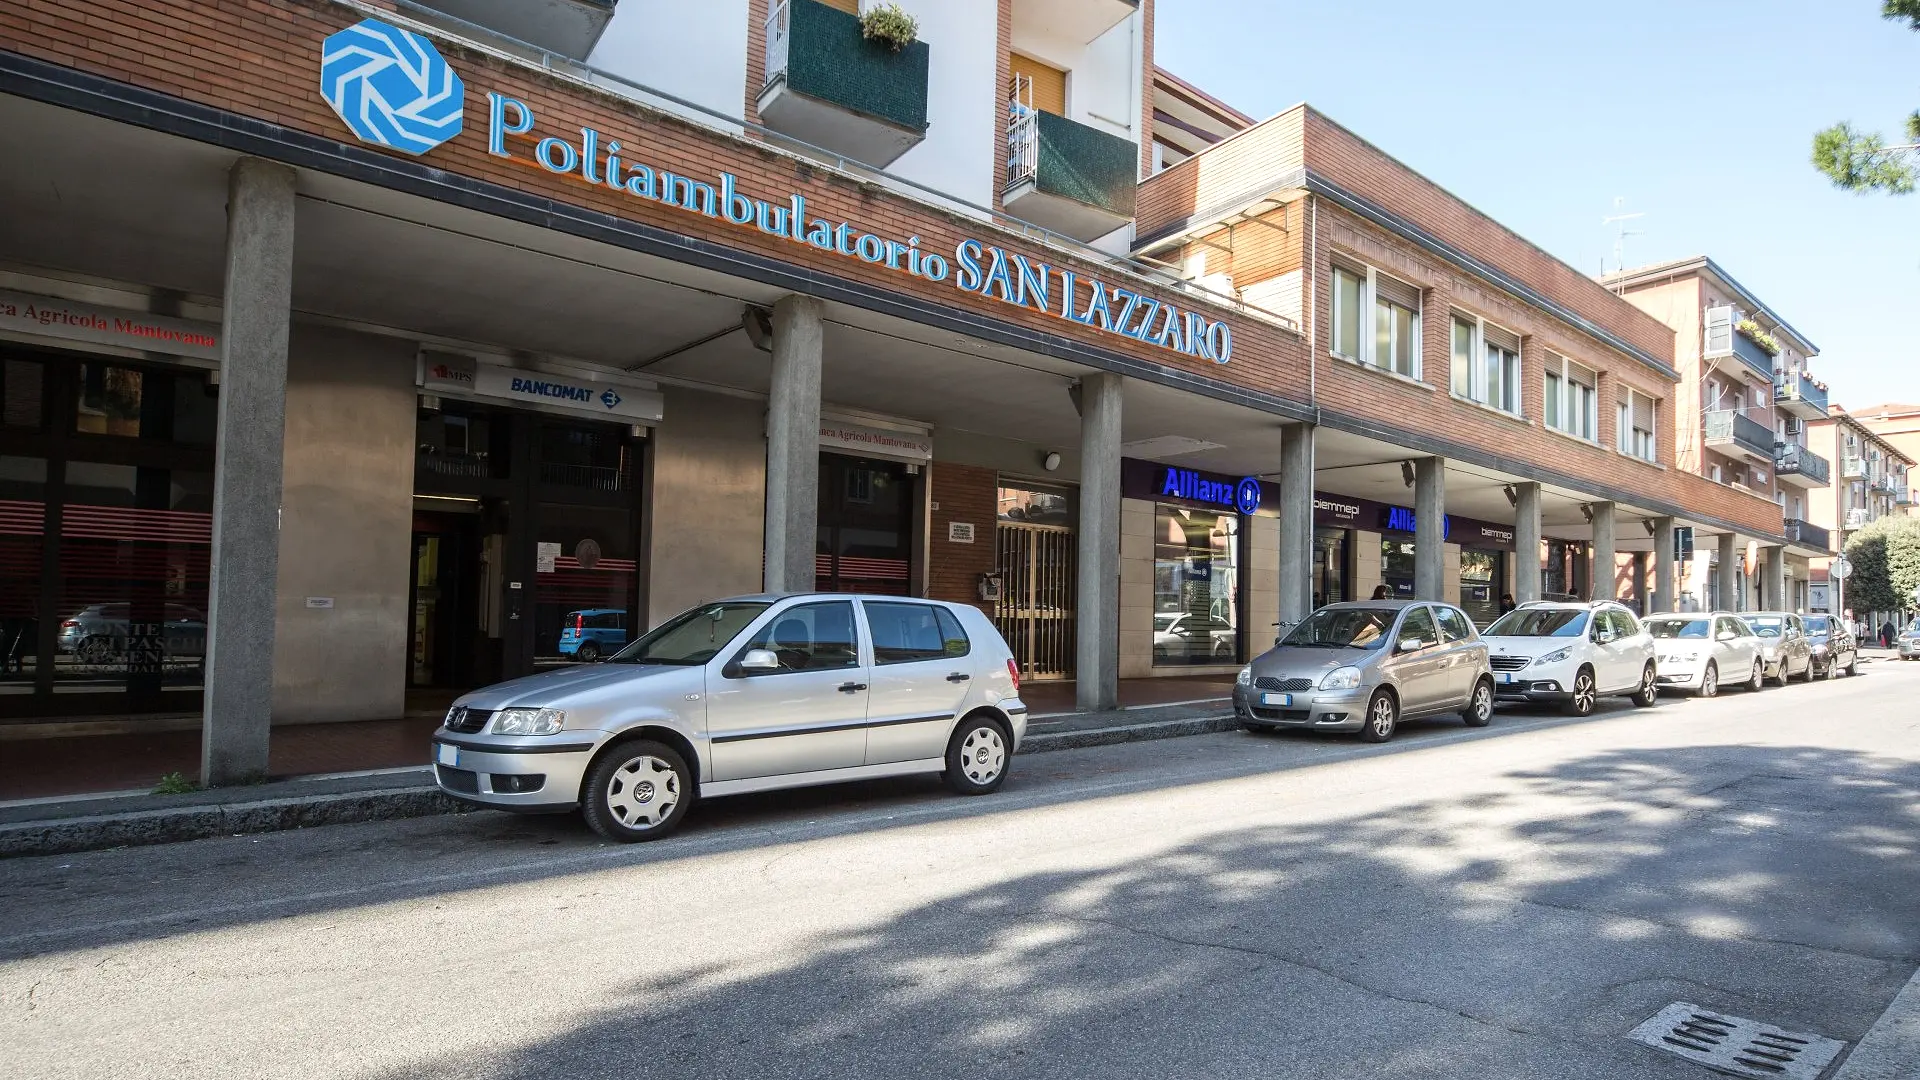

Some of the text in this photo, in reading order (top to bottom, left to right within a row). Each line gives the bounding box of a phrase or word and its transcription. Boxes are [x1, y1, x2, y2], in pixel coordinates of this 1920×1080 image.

[486, 91, 1233, 365] Poliambulatorio SAN LAZZARO
[23, 303, 108, 331] Agricola
[114, 317, 215, 348] Mantovana
[511, 377, 594, 402] BANCOMAT
[836, 429, 872, 443] Agricola
[873, 435, 916, 450] Mantovana
[1162, 467, 1234, 505] Allianz
[1387, 506, 1416, 532] Allia
